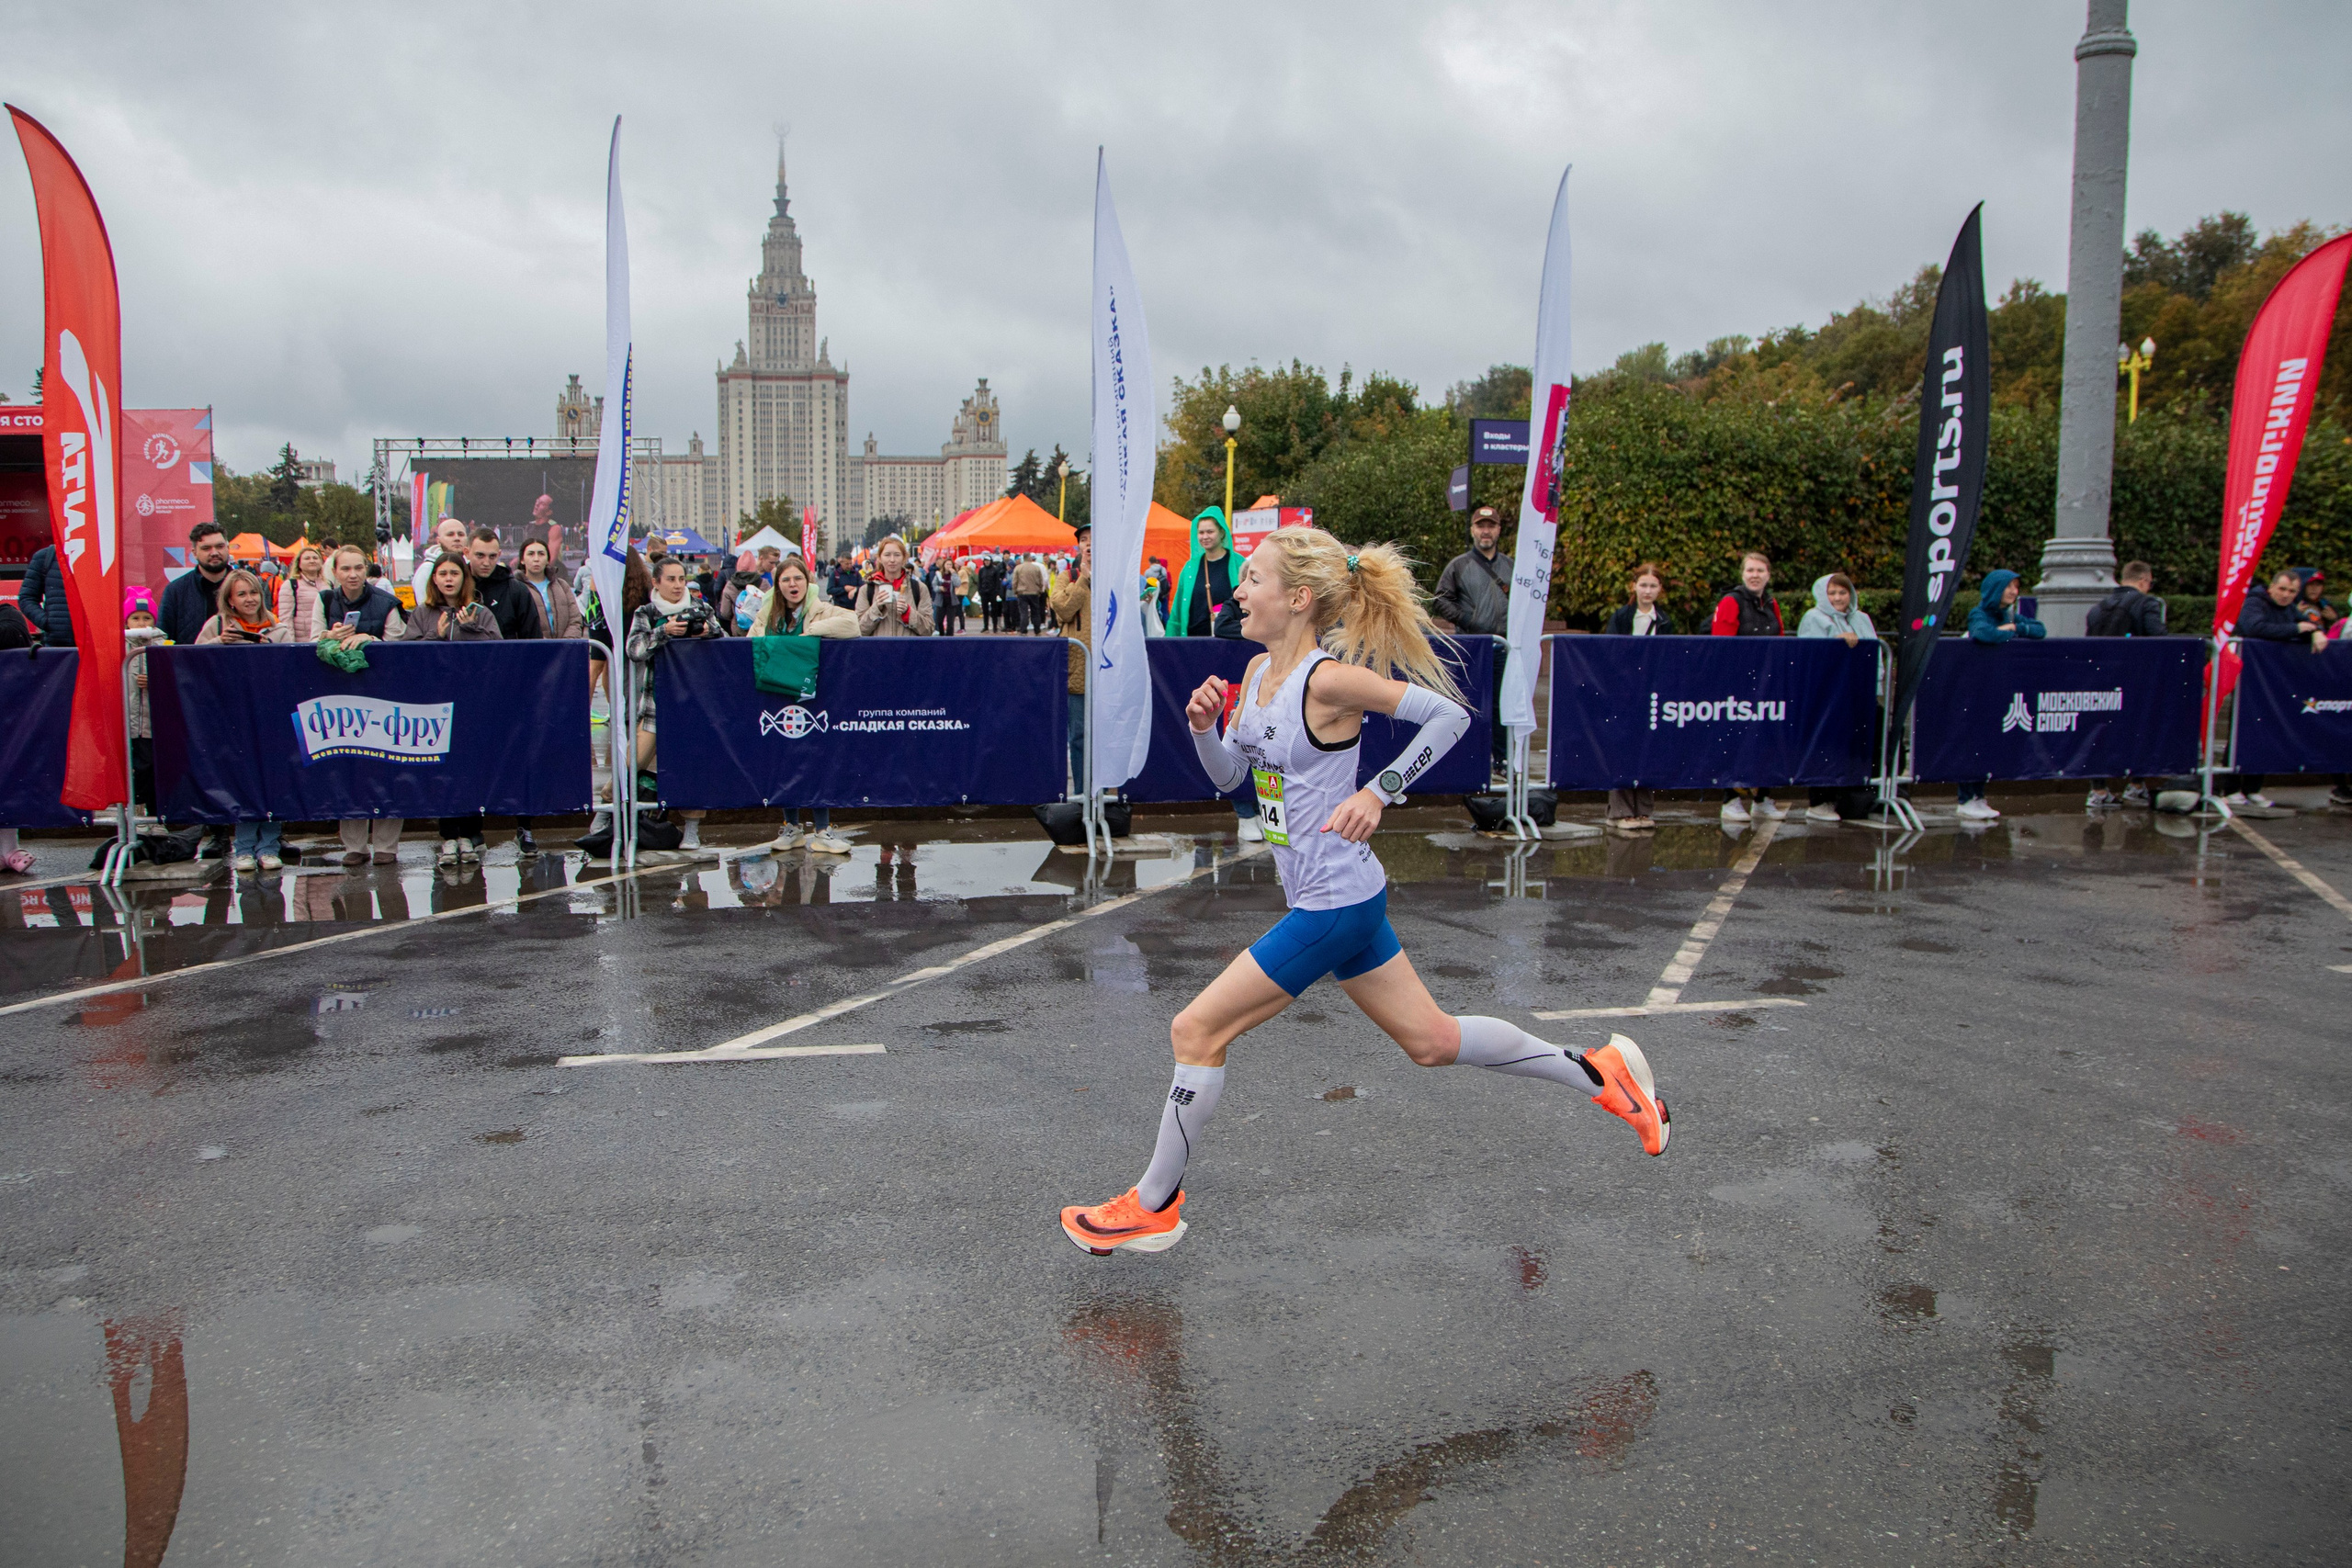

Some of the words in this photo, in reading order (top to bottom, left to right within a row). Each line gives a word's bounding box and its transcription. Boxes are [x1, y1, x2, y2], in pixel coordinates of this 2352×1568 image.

[14, 415, 44, 426] СТО
[1483, 431, 1511, 441] Входы
[1928, 344, 1963, 604] sports.ru
[155, 498, 189, 506] pharmeco
[2037, 686, 2123, 712] МОСКОВСКИЙ
[858, 709, 893, 718] группа
[896, 707, 946, 717] компаний
[1661, 695, 1786, 728] sports.ru
[308, 701, 448, 747] фру-фру
[832, 720, 905, 733] «СЛАДКАЯ
[908, 719, 970, 731] СКАЗКА»
[2036, 712, 2080, 732] СПОРТ
[311, 747, 385, 761] жевательный
[388, 754, 441, 762] мармелад
[1260, 804, 1280, 827] 14
